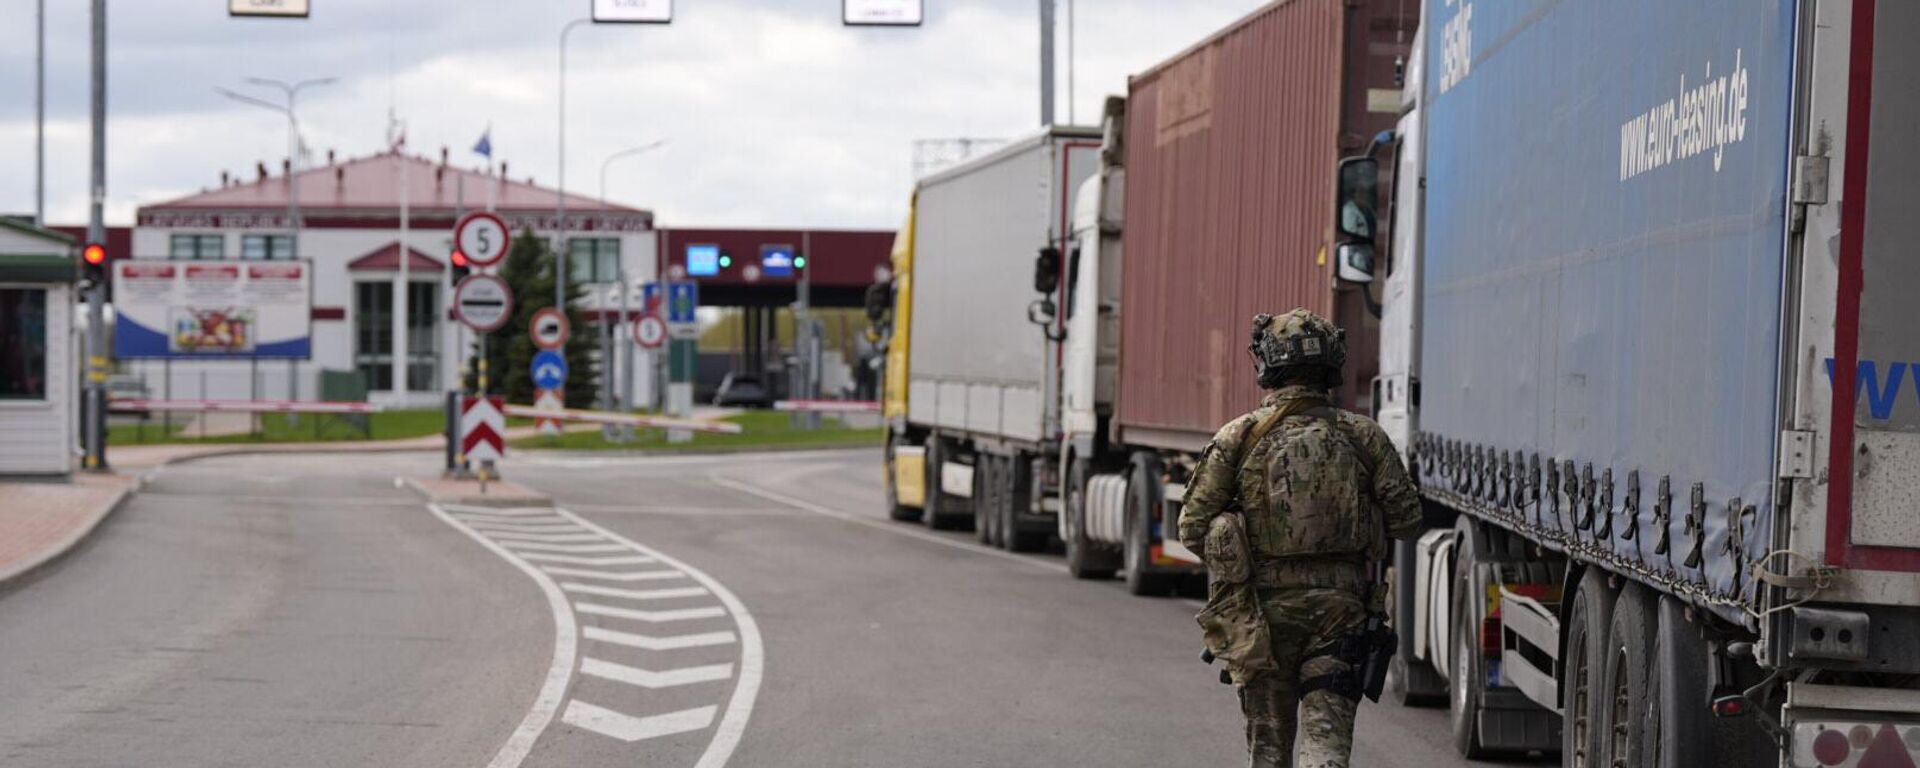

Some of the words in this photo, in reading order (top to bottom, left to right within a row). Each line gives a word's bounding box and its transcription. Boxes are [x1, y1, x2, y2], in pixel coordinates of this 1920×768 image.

[1440, 2, 1472, 94] LEASING
[1620, 48, 1748, 182] www.euro-leasing.de
[477, 227, 490, 254] 5
